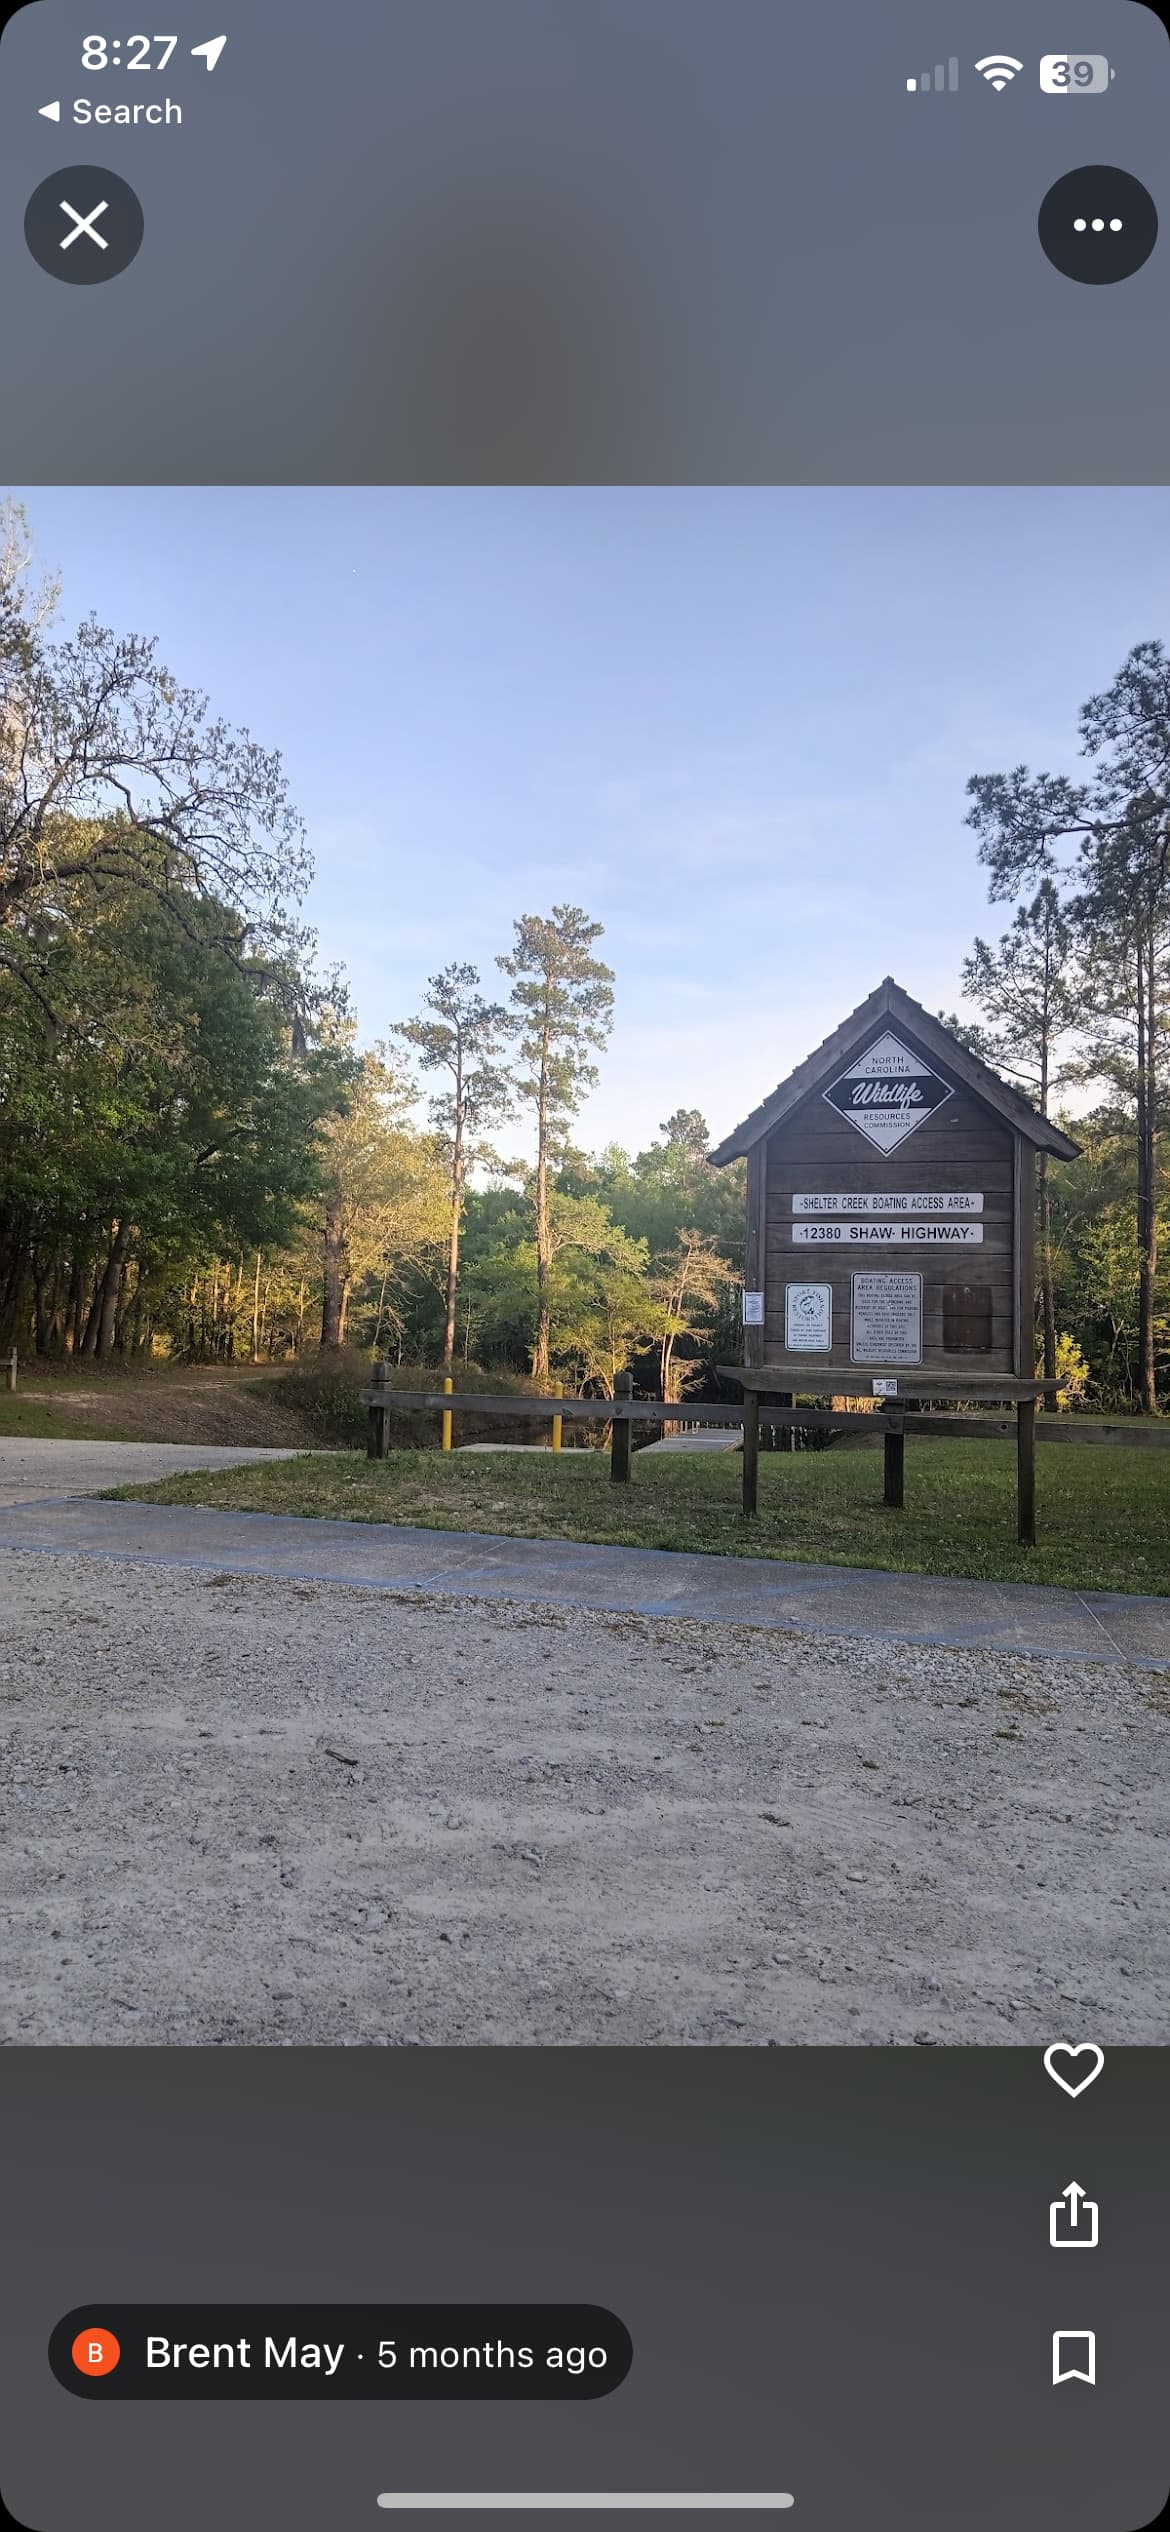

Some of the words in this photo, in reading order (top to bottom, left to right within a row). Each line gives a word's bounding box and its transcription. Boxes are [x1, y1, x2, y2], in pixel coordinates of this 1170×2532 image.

[872, 1056, 904, 1064] NORTH
[865, 1065, 911, 1074] CAROLINA
[852, 1081, 924, 1109] Wildlife
[863, 1113, 911, 1121] RESOURCES
[864, 1121, 911, 1129] COMMISSION
[803, 1197, 838, 1209] SHELTER
[841, 1197, 868, 1209] CREEK
[872, 1197, 908, 1209] BOATING
[911, 1197, 944, 1209] ACCESS
[947, 1197, 970, 1209] AREA
[803, 1227, 841, 1240] 12380
[849, 1227, 892, 1239] SHAW
[901, 1227, 970, 1239] HIGHWAY
